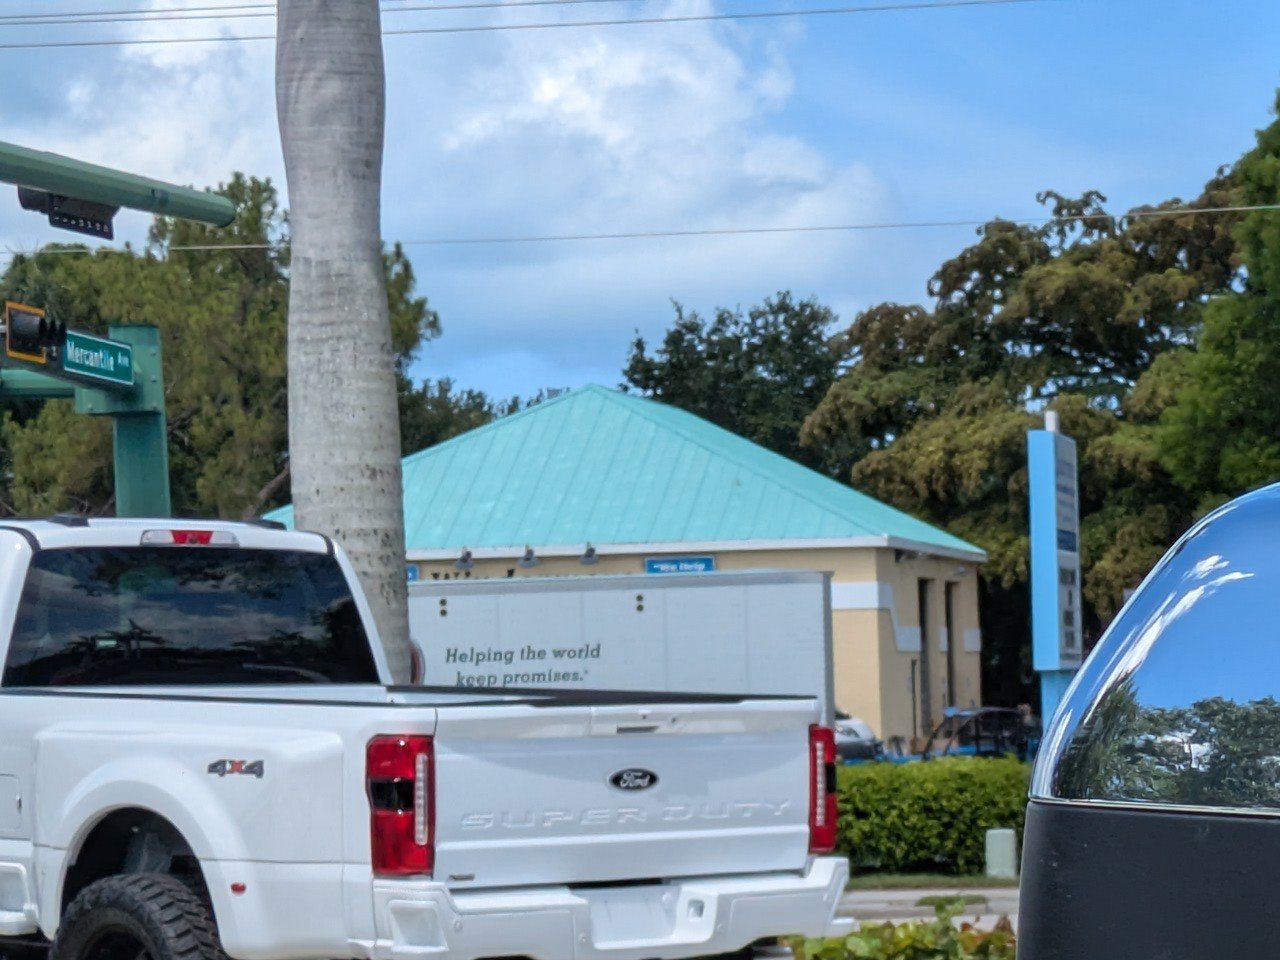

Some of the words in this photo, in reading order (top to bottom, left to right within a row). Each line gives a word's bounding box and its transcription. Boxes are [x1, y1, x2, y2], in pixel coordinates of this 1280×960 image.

[446, 647, 515, 666] Helping
[520, 645, 547, 660] the
[551, 644, 601, 660] world
[456, 671, 498, 687] keep
[620, 771, 651, 788] Ford
[461, 806, 648, 830] SUPER
[661, 800, 793, 822] DUTY
